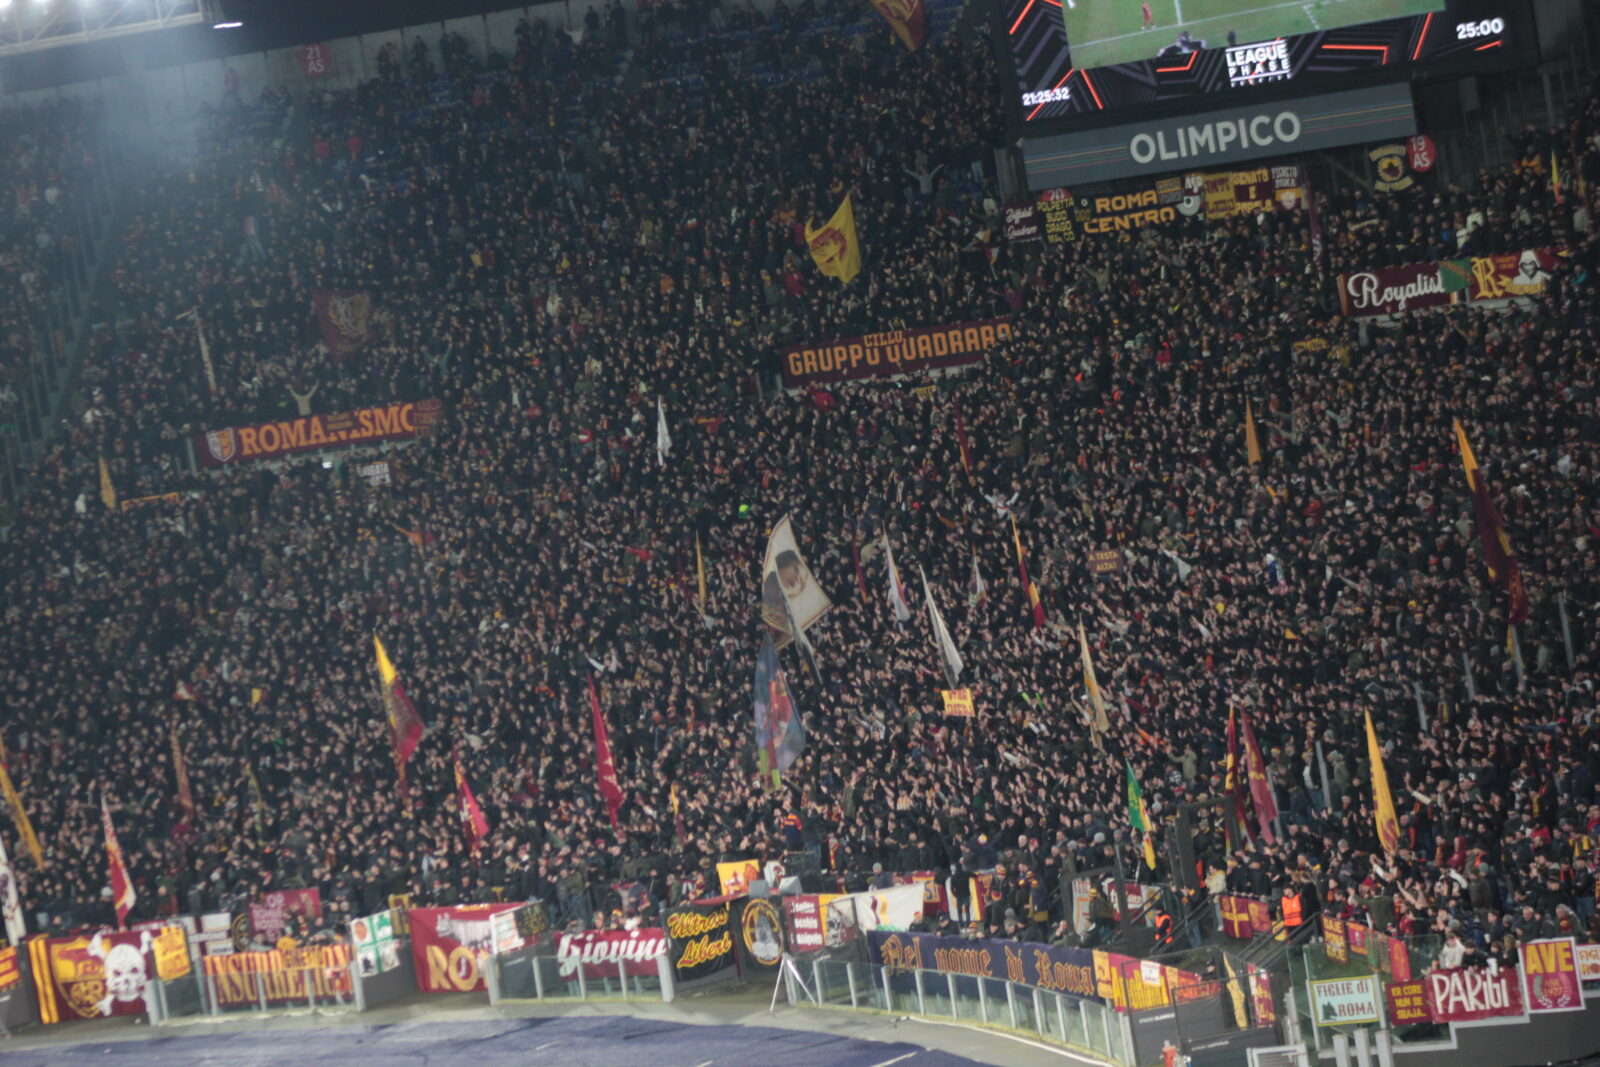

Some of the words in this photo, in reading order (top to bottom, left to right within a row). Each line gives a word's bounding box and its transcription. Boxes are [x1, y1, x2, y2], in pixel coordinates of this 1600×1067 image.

[1456, 17, 1504, 40] 25:00
[306, 46, 320, 59] 21
[1226, 43, 1288, 67] LEAGUE
[308, 59, 325, 73] AS
[1228, 58, 1291, 78] PHASE
[1022, 87, 1070, 106] 21:25:32
[1130, 111, 1301, 163] OLIMPICO
[1410, 135, 1425, 152] 19
[1413, 152, 1430, 168] AS
[1095, 190, 1158, 213] ROMA
[1084, 207, 1175, 234] CENTRO
[667, 908, 728, 939] Ultras
[677, 931, 732, 968] Liberi
[1526, 942, 1574, 975] AVE
[426, 945, 488, 991] RO
[880, 935, 922, 976] Nel
[935, 948, 992, 977] nome
[1004, 945, 1026, 984] di
[1033, 949, 1095, 996] Roma
[1316, 982, 1353, 997] FIGLIE
[1391, 987, 1401, 996] ER
[1403, 985, 1424, 996] CORE
[1338, 1001, 1374, 1017] ROMA
